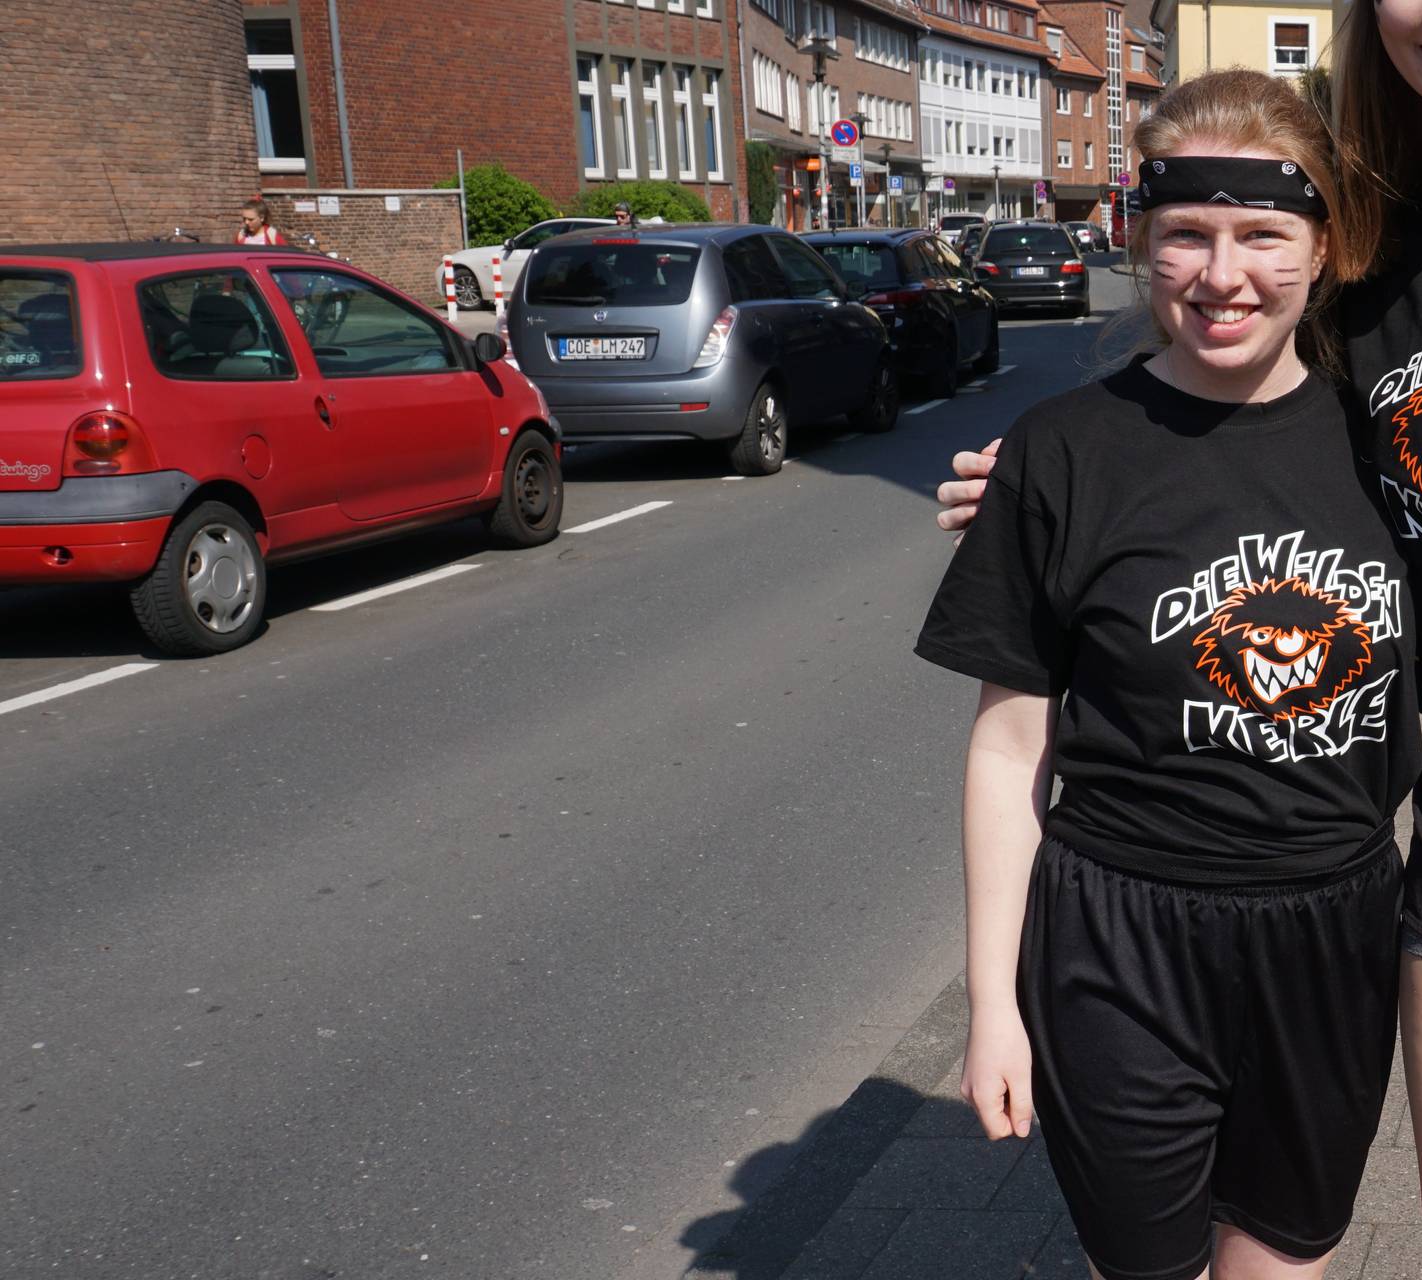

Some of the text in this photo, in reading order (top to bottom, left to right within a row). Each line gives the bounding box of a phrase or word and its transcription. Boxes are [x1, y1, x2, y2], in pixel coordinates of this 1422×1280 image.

[567, 340, 591, 354] COE
[621, 339, 644, 353] 247
[1183, 669, 1399, 763] KERLE
